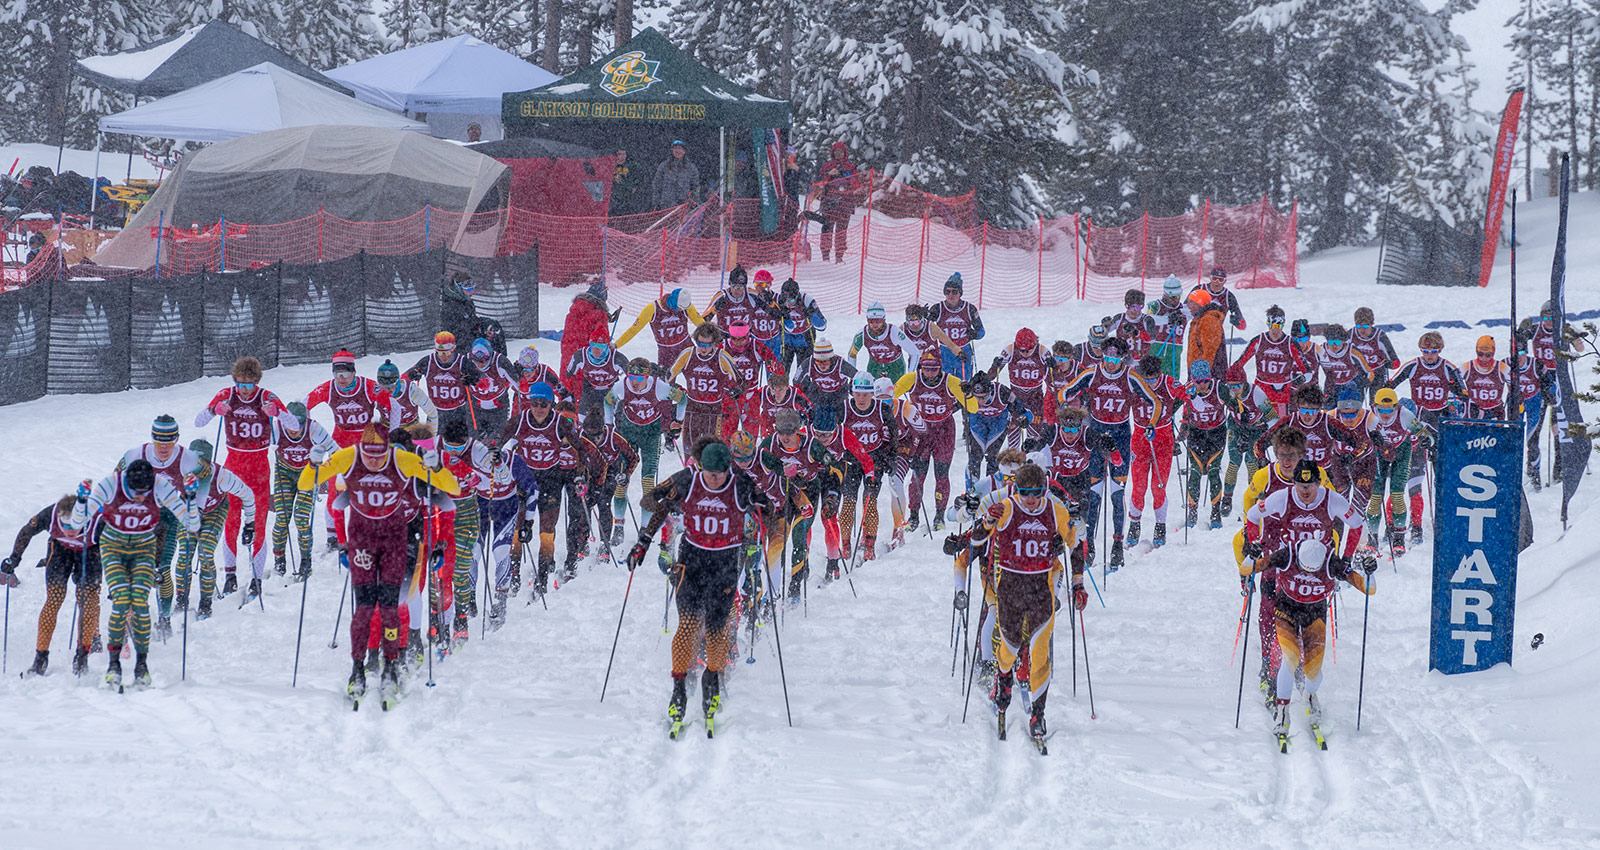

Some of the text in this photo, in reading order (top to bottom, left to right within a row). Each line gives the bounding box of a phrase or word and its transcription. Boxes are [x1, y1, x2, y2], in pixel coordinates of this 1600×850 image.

[520, 101, 706, 121] CLARKSON GOLDEN KNIGHTS
[658, 324, 685, 338] 170
[752, 318, 777, 332] 180
[944, 326, 968, 340] 182
[1535, 347, 1555, 360] 18
[1260, 359, 1287, 374] 167
[1012, 368, 1040, 380] 166
[430, 385, 461, 399] 150
[689, 377, 719, 393] 152
[1415, 386, 1444, 400] 159
[1470, 388, 1499, 400] 169
[917, 402, 947, 415] 156
[1093, 397, 1127, 413] 147
[335, 412, 369, 426] 140
[1191, 410, 1218, 422] 157
[229, 420, 264, 439] 130
[858, 431, 879, 445] 46
[1466, 434, 1498, 450] TOKO
[520, 446, 557, 462] 132
[1305, 447, 1327, 461] 35
[1053, 455, 1085, 469] 137
[359, 481, 394, 489] USCSA
[352, 490, 400, 507] 102
[112, 513, 153, 529] 104
[691, 515, 730, 535] 101
[1012, 539, 1050, 558] 103
[1450, 464, 1498, 666] START
[1288, 579, 1326, 596] 105
